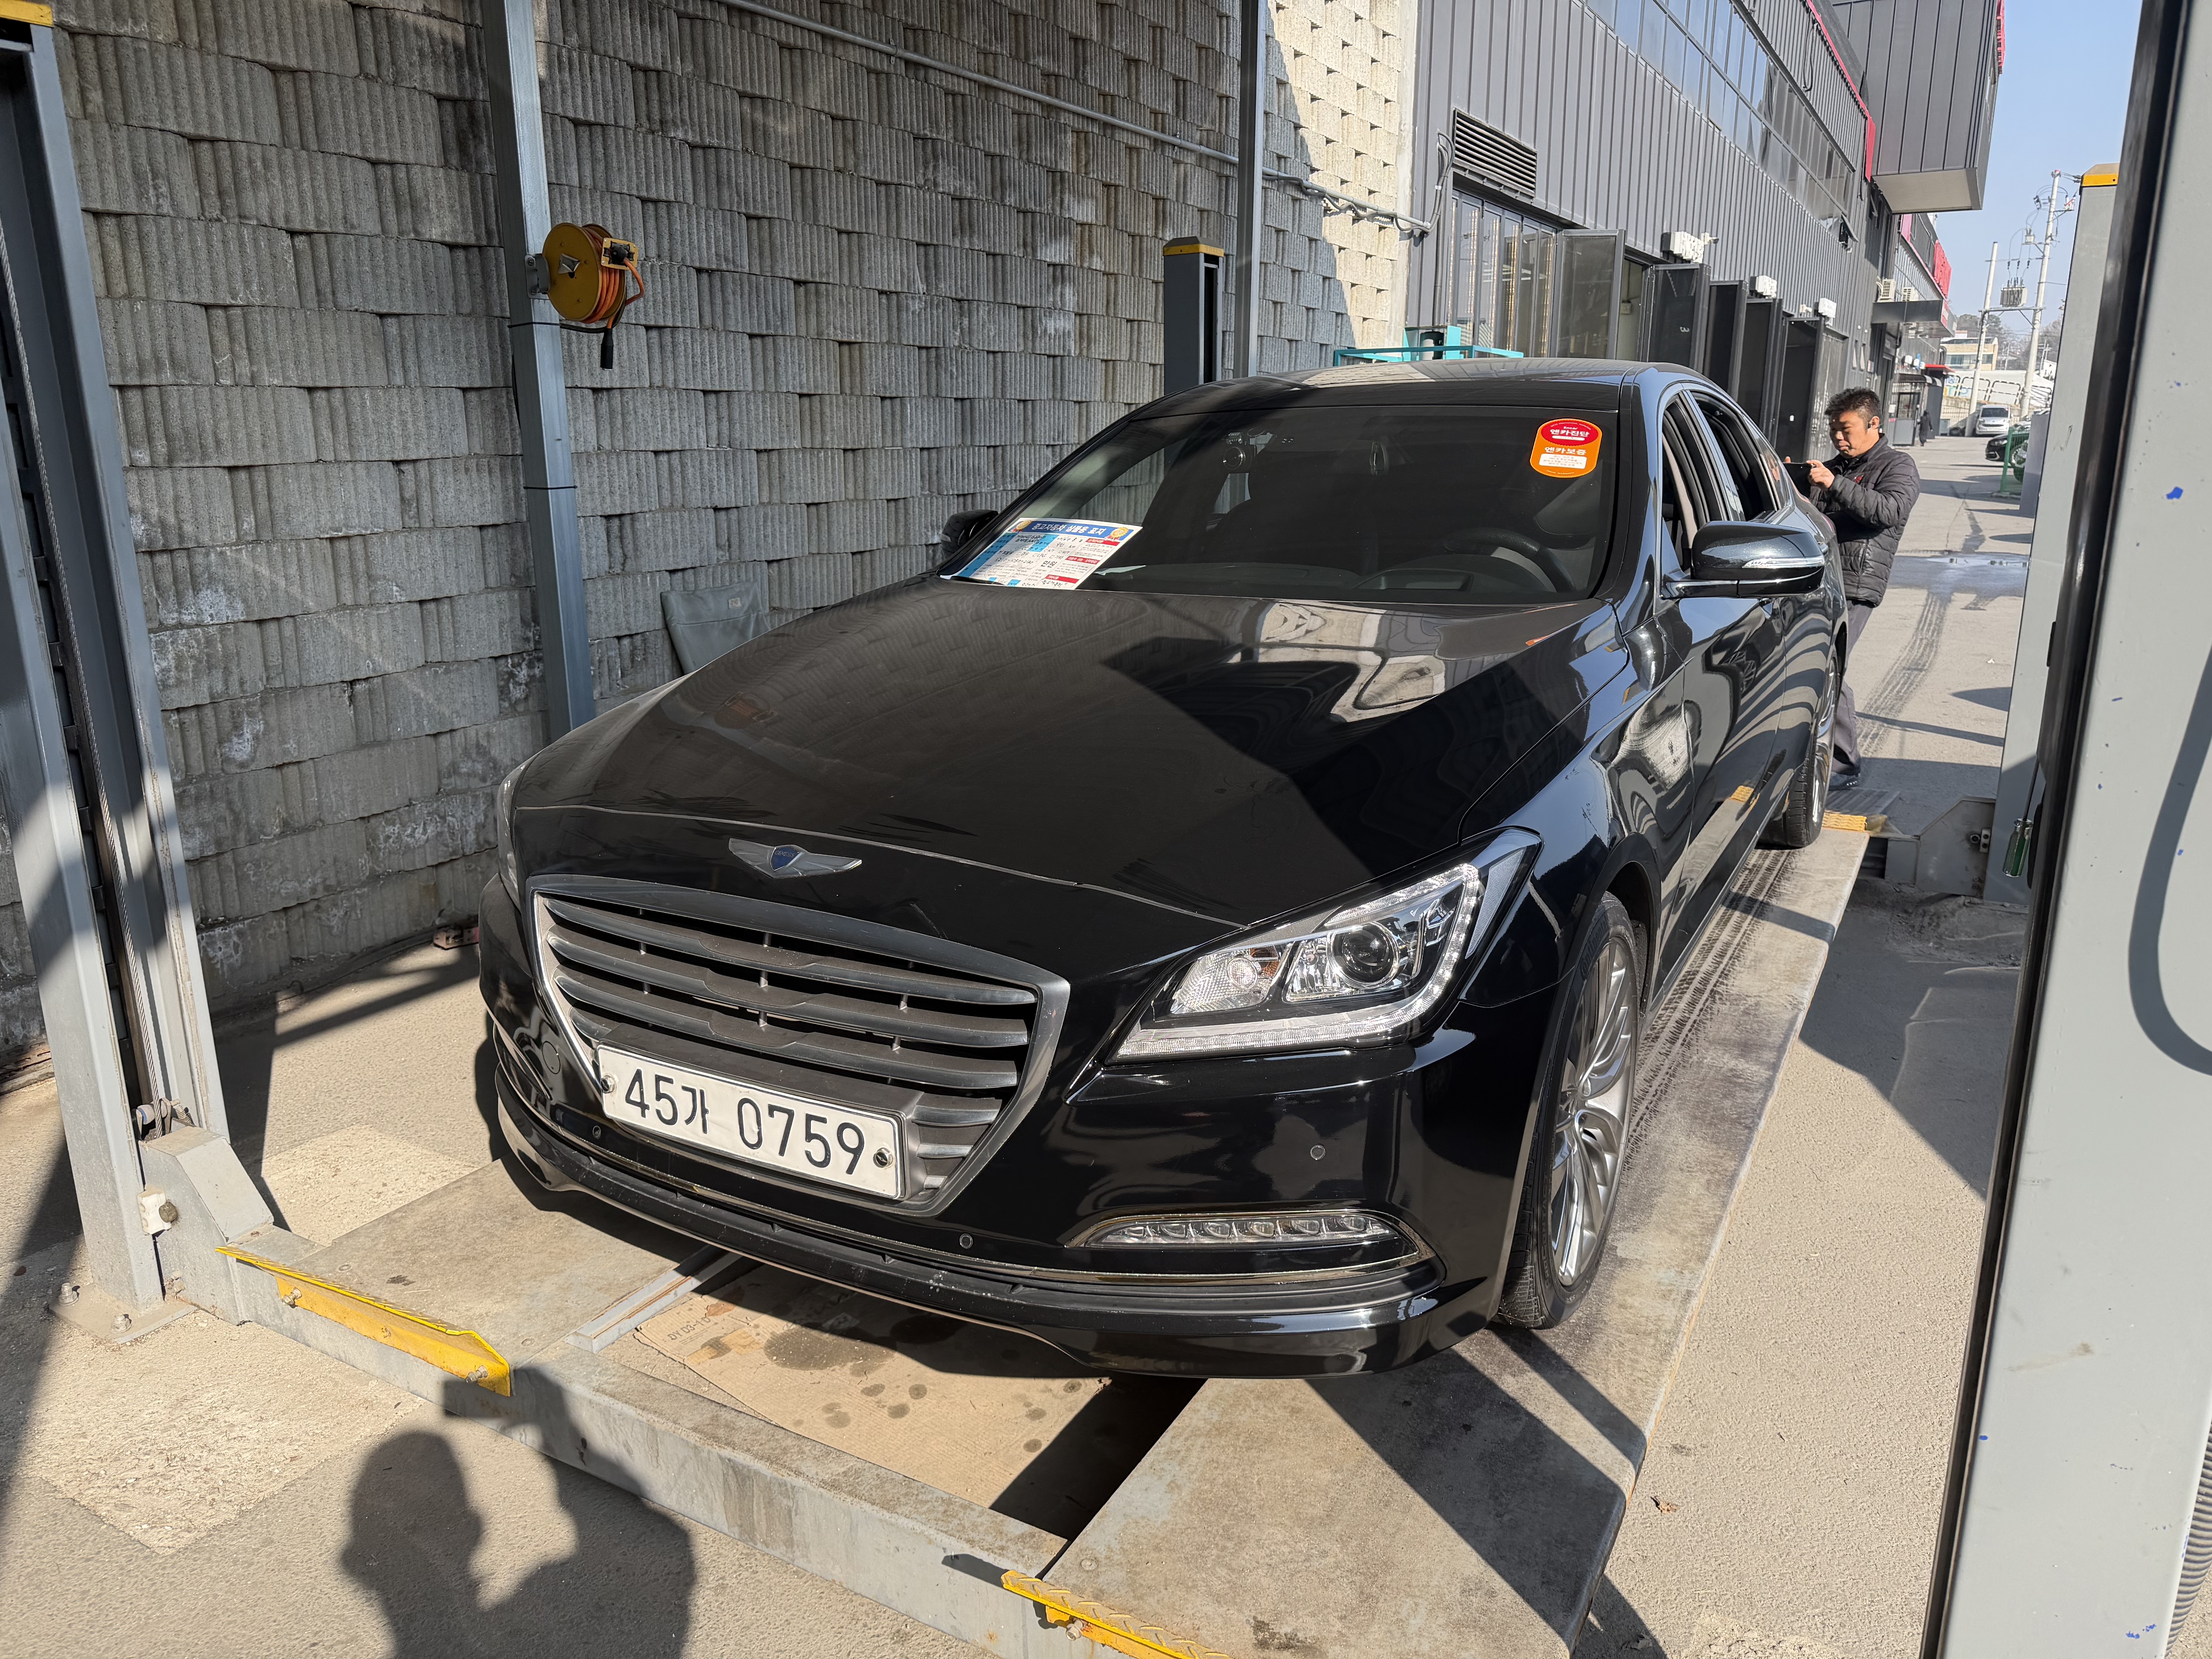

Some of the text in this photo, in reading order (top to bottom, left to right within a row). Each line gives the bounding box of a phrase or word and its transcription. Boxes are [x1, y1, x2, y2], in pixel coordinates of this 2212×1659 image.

[1544, 447, 1587, 455] 엔카보증
[1032, 523, 1065, 531] 중고자동차
[624, 1068, 865, 1175] 45가 0759
